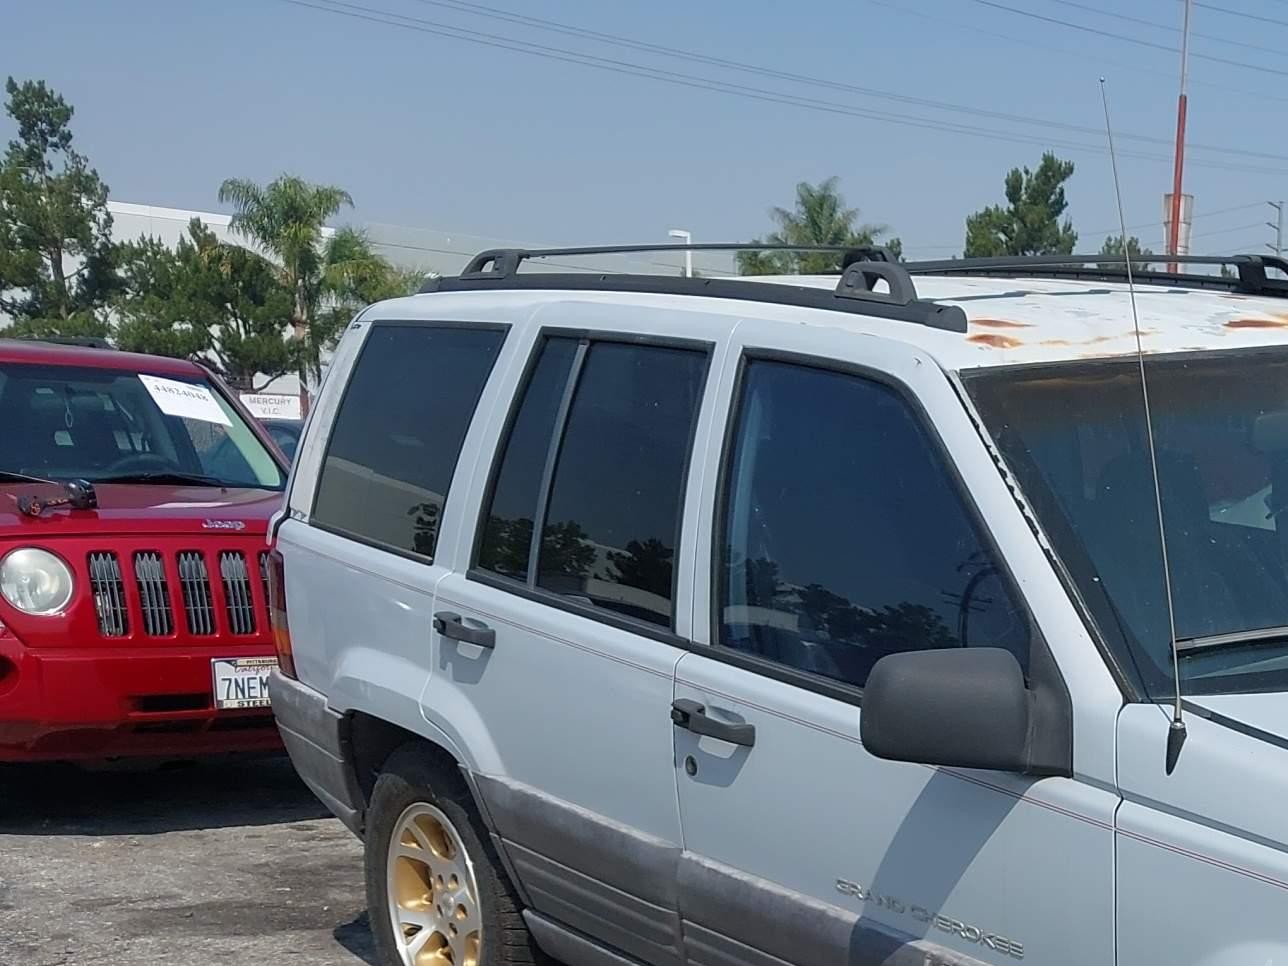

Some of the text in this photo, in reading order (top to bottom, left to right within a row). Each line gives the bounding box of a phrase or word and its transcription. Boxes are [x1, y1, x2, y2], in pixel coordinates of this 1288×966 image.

[249, 396, 291, 405] MERCURY
[202, 519, 246, 531] Jeep
[836, 878, 1025, 960] GRAND CHEROKEE
